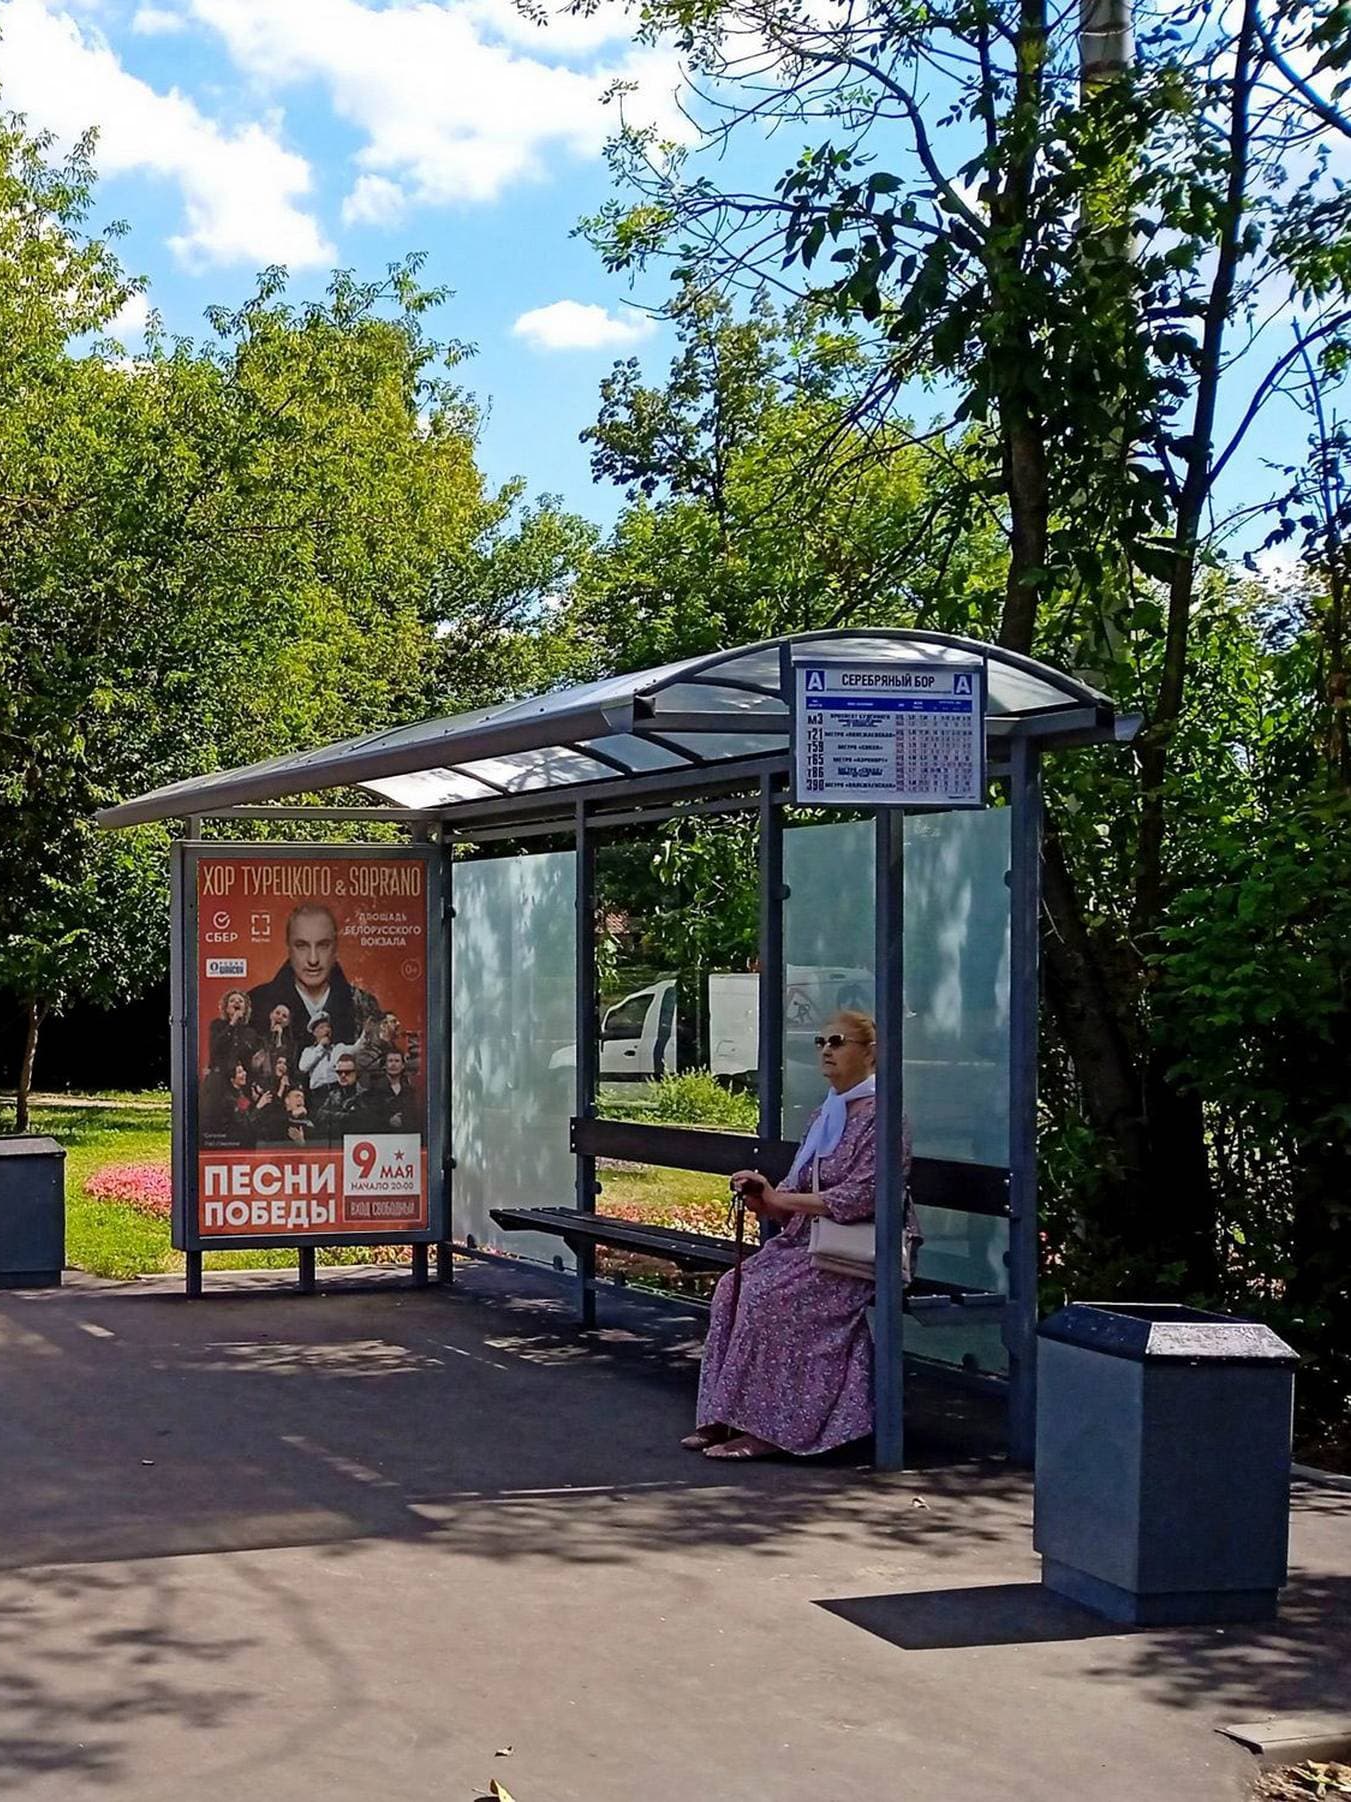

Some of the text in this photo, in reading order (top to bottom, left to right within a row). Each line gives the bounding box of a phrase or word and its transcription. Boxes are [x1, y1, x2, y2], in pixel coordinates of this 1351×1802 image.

[842, 673, 936, 689] СЕРЕБРЯНЫЙ БОР
[202, 865, 421, 899] ХОР ТУРЕЦКОГО & SOPRANO
[359, 912, 407, 922] ПЛОЩАДЬ
[205, 932, 238, 943] СБЕР
[344, 925, 422, 936] БЕЛОРУССКОГО
[360, 936, 407, 947] ВОКЗАЛА
[352, 1140, 377, 1179] 9
[380, 1165, 414, 1179] МАЯ
[204, 1163, 336, 1197] ПЕСНИ
[351, 1182, 389, 1191] НАЧАЛО
[204, 1199, 336, 1229] ПОБЕДЫ
